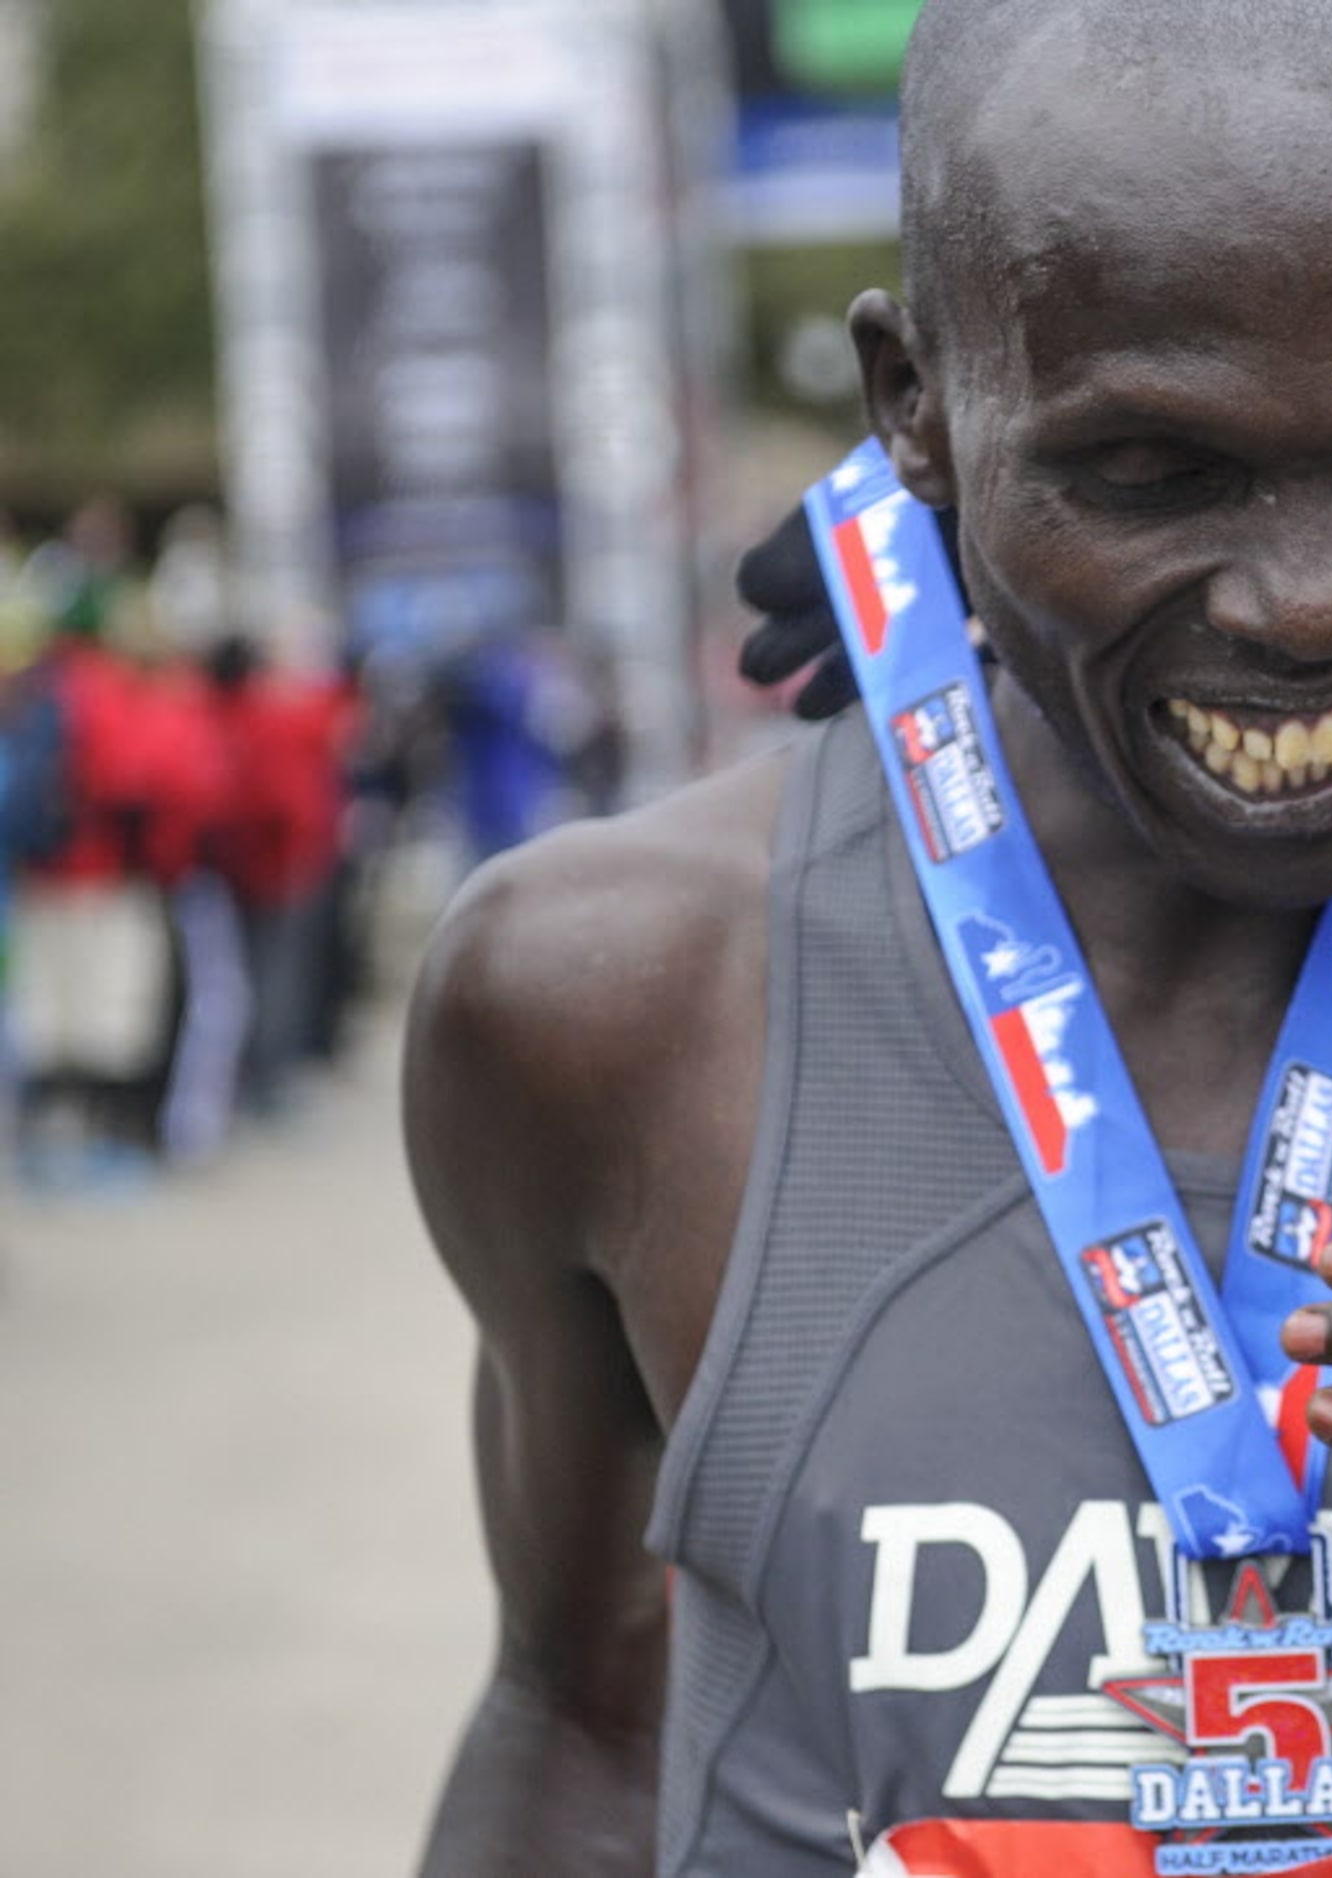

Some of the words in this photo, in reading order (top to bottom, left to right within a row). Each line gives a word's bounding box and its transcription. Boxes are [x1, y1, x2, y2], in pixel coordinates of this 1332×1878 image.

[1147, 1225, 1191, 1303] Rock
[1140, 1301, 1199, 1408] DALLAS
[1184, 1647, 1332, 1793] 5
[1162, 1851, 1224, 1869] HALF
